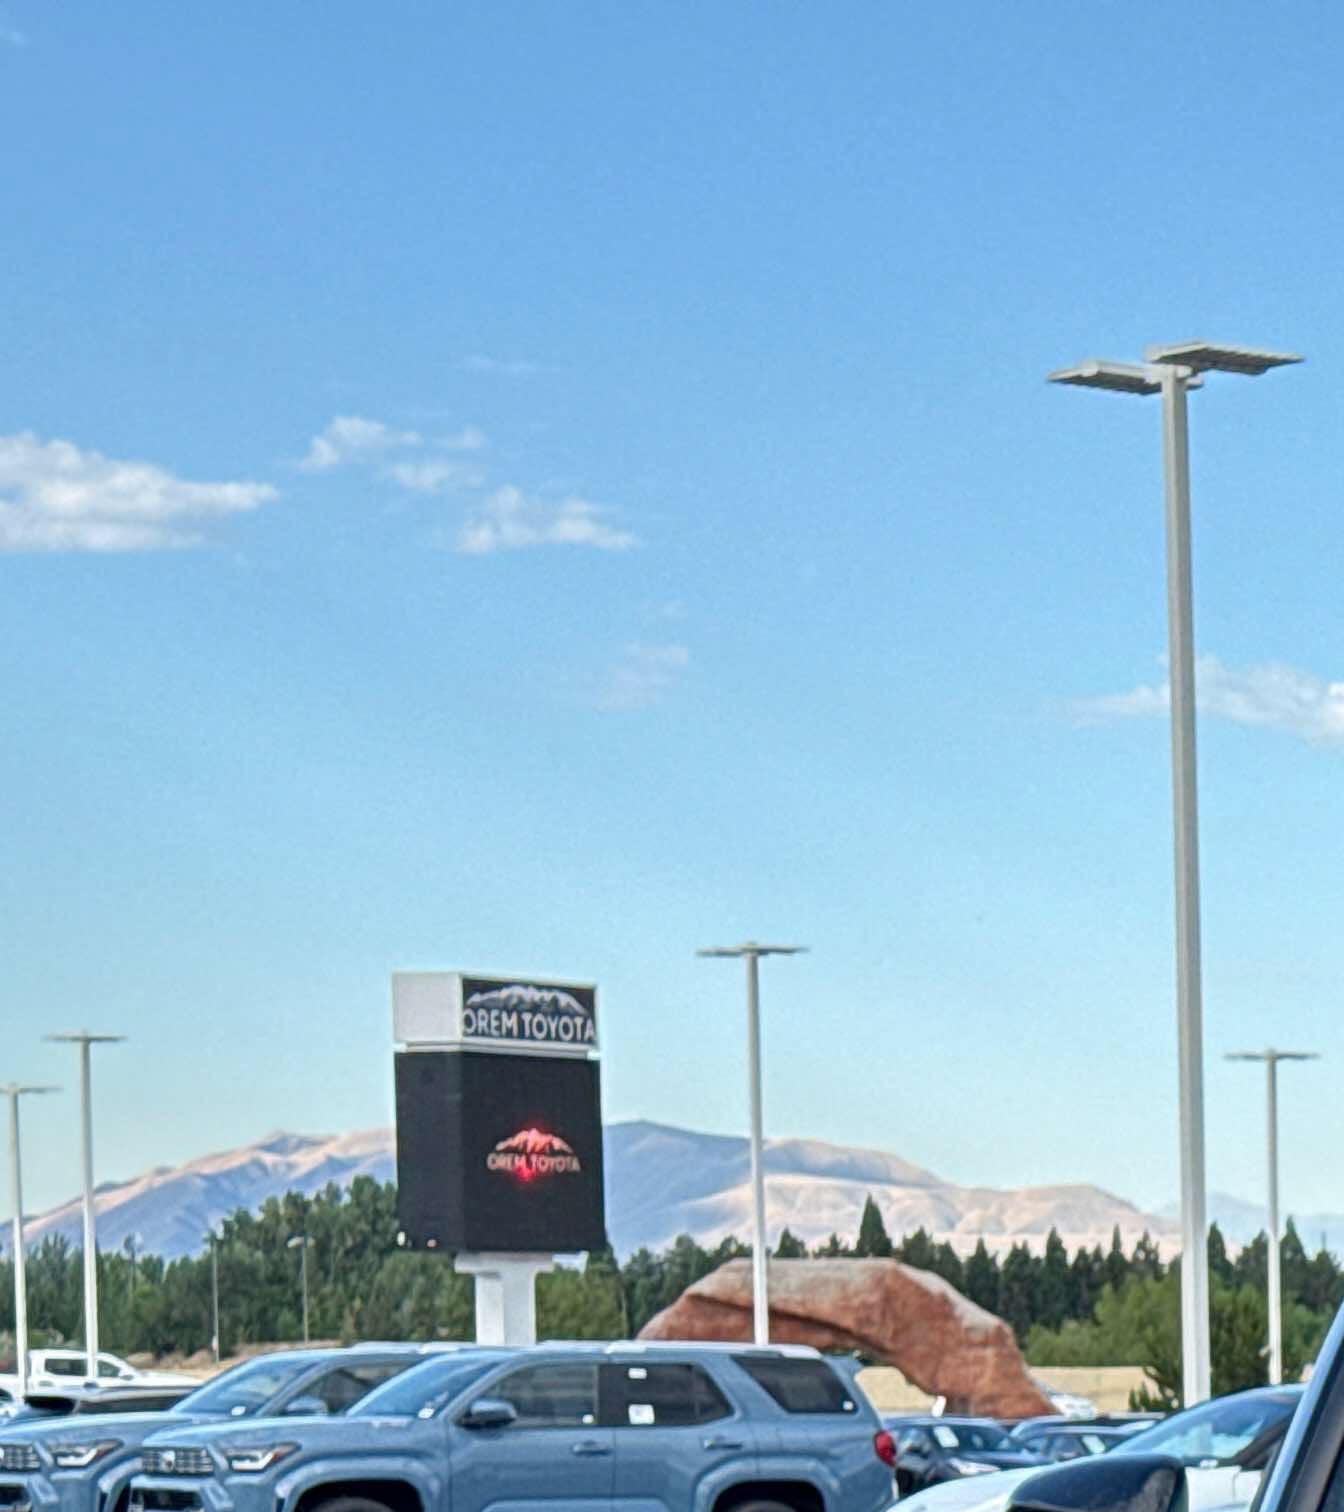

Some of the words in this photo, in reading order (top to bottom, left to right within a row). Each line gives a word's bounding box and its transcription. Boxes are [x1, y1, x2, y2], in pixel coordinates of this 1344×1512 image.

[462, 1007, 519, 1038] OREM
[521, 1011, 595, 1041] TOYOTA
[486, 1152, 528, 1171] OREM
[530, 1153, 581, 1173] TOYOTA
